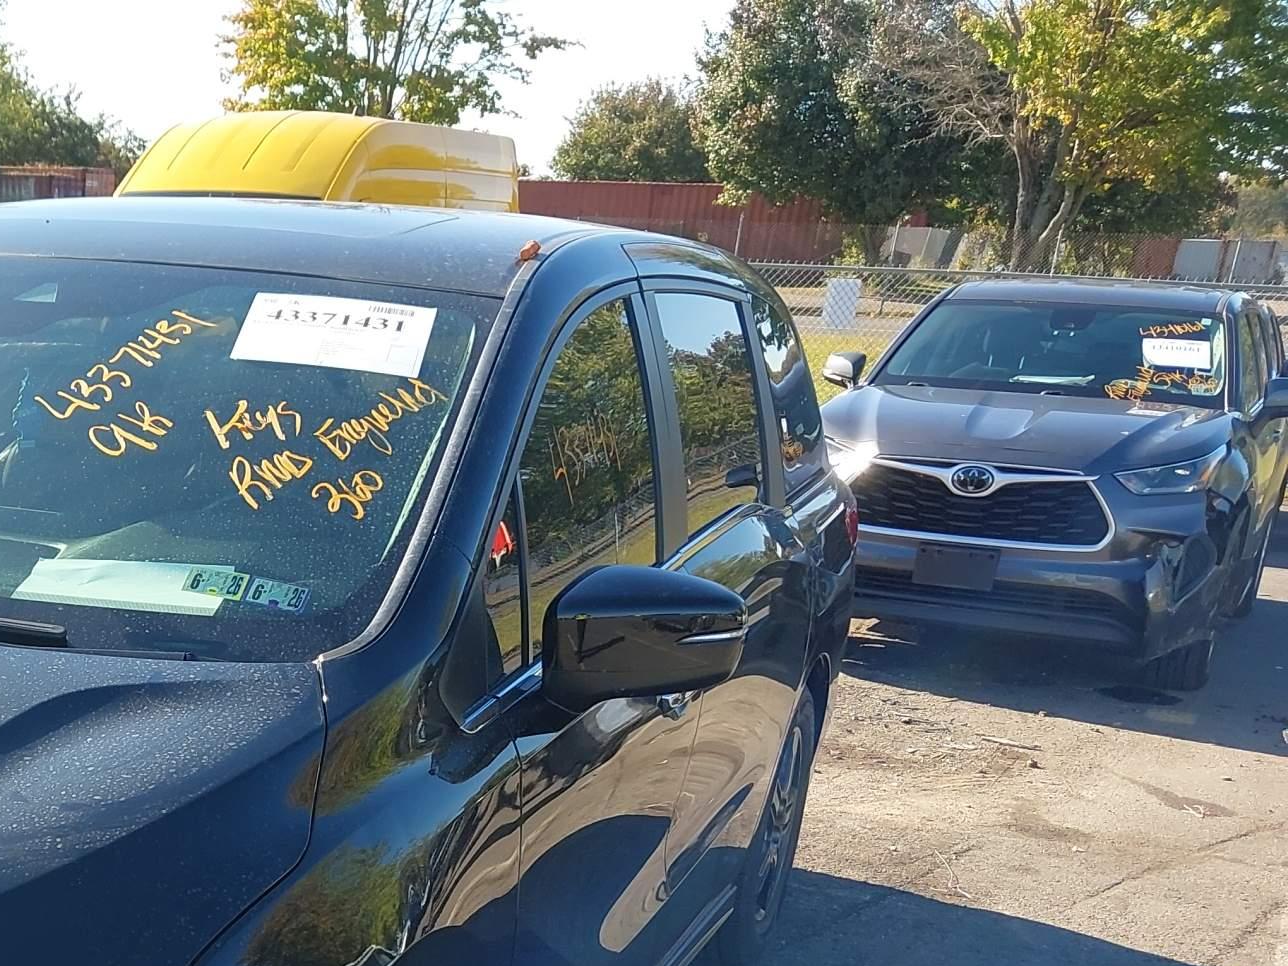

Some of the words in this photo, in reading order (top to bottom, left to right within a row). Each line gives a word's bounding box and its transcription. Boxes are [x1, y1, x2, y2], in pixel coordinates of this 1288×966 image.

[267, 309, 404, 332] 43371431
[34, 311, 216, 418] 43371431
[226, 575, 244, 596] 26
[287, 588, 306, 609] 26
